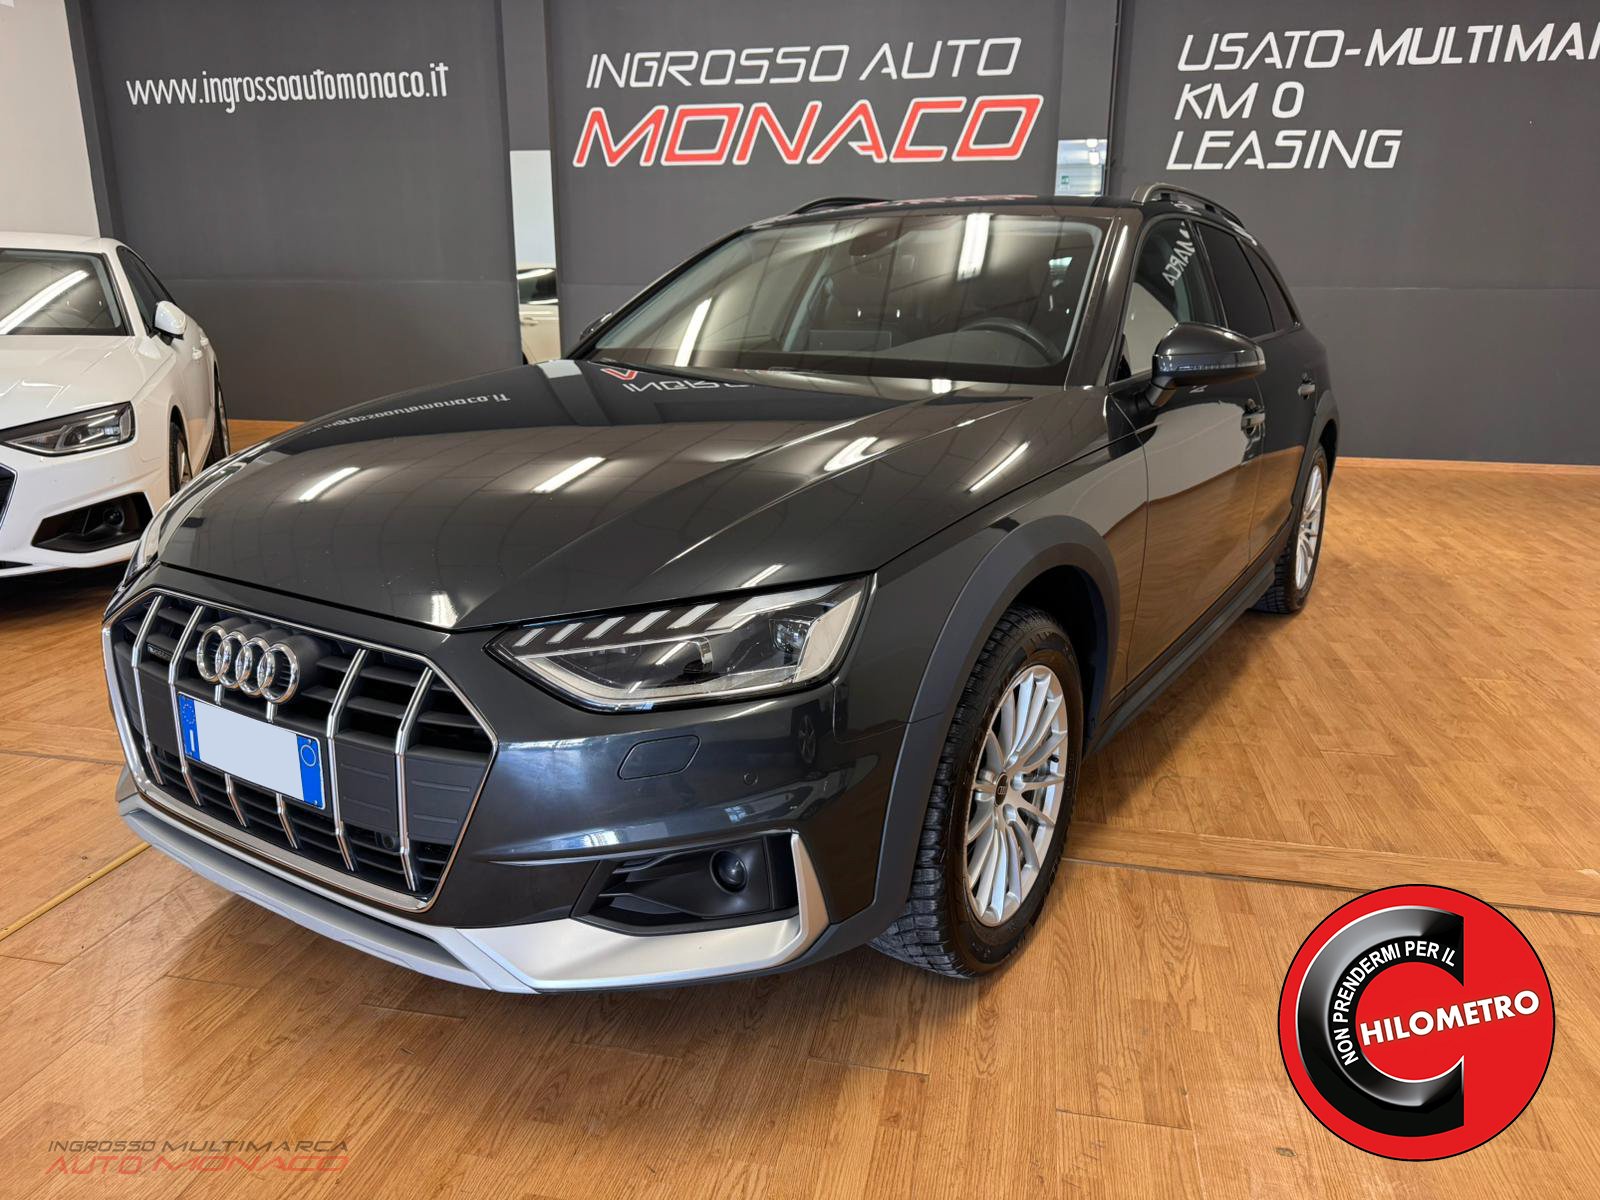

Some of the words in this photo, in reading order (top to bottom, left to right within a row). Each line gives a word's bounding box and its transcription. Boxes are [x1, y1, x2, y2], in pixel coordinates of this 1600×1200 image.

[126, 62, 449, 114] www.ingrossoautomonaco.it
[586, 44, 850, 89] INGROSSO
[858, 36, 1022, 81] AUTO
[1173, 81, 1258, 121] KM
[572, 93, 1045, 168] MONACO
[1165, 128, 1404, 171] LEASING
